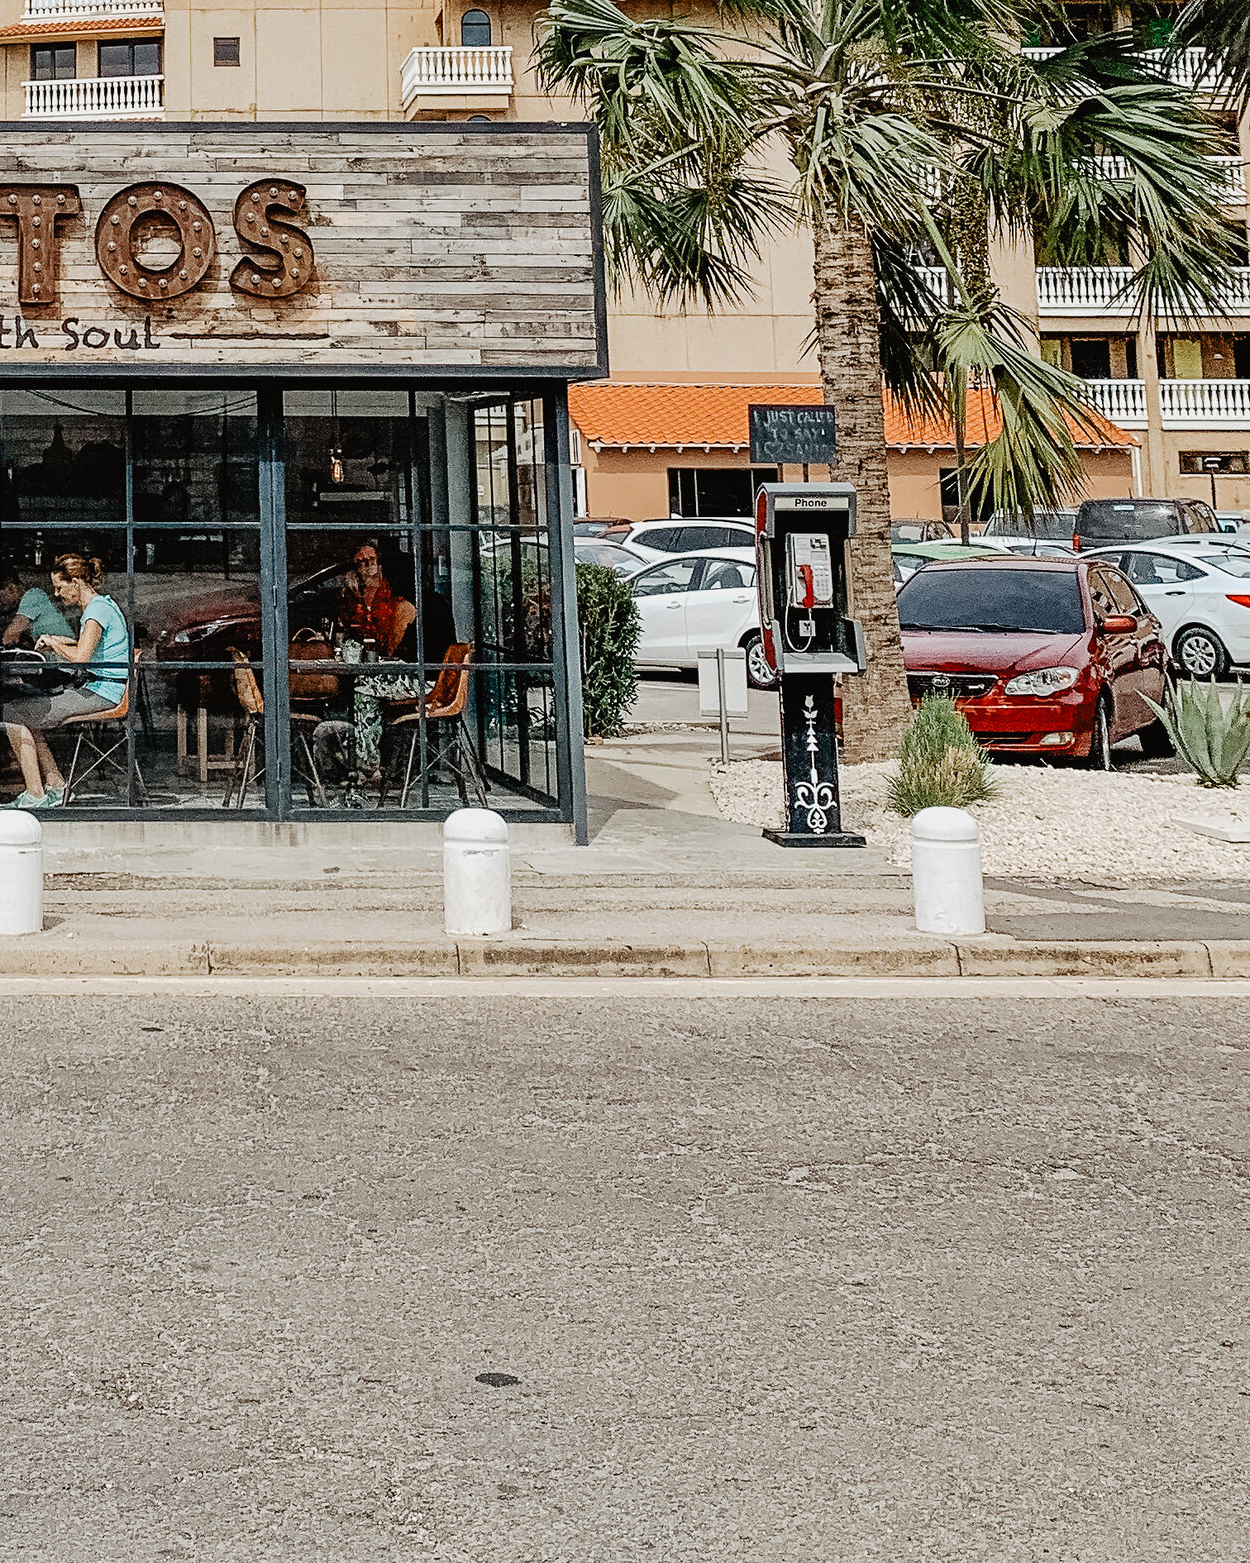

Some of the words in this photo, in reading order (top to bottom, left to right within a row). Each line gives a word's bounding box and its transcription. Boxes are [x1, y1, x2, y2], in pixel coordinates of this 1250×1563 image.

[65, 317, 161, 351] Soul
[762, 409, 795, 428] JUST
[797, 410, 834, 424] CALLED
[794, 498, 827, 507] Phone
